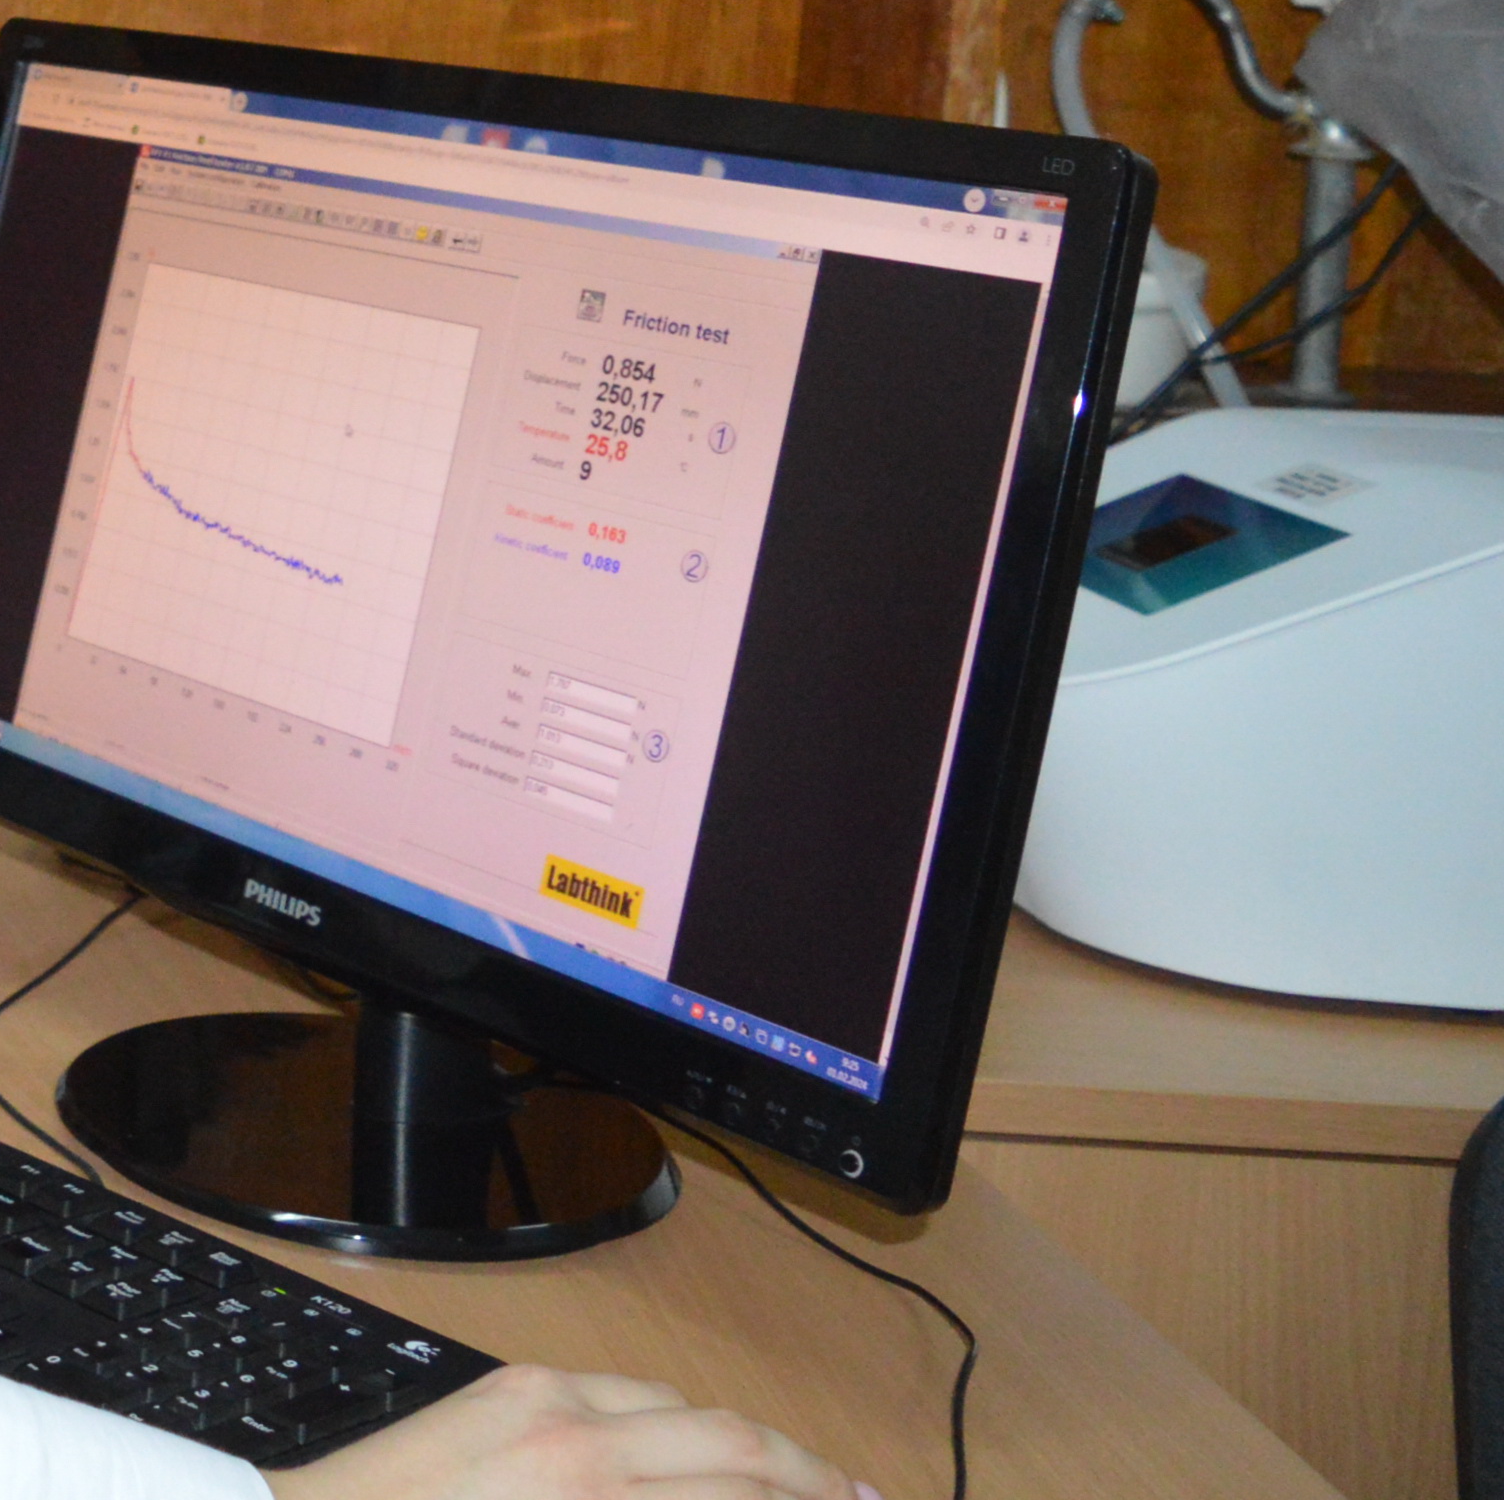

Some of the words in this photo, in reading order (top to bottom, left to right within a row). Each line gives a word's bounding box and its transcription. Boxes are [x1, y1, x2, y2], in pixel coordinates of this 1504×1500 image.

[1042, 156, 1075, 176] LED
[622, 309, 690, 338] Friction
[695, 323, 730, 345] test
[561, 351, 587, 366] Force
[602, 354, 656, 384] 0,854
[523, 370, 581, 392] Displacement
[596, 381, 664, 413] 250,17
[555, 401, 576, 416] Time
[591, 408, 646, 438] 32,06
[519, 421, 570, 442] Temperature
[585, 433, 629, 462] 25,8
[531, 453, 565, 470] Amount
[579, 460, 592, 480] 9
[583, 552, 621, 574] 0,089
[244, 879, 322, 926] PHILIPS
[546, 865, 634, 919] Labthink
[310, 1295, 352, 1315] K120
[46, 1355, 62, 1364] 0
[187, 1349, 204, 1358] 5
[282, 1359, 298, 1368] 9
[142, 1364, 159, 1373] 2
[239, 1374, 255, 1383] 6
[194, 1389, 211, 1398] 3
[242, 1416, 275, 1433] Enter
